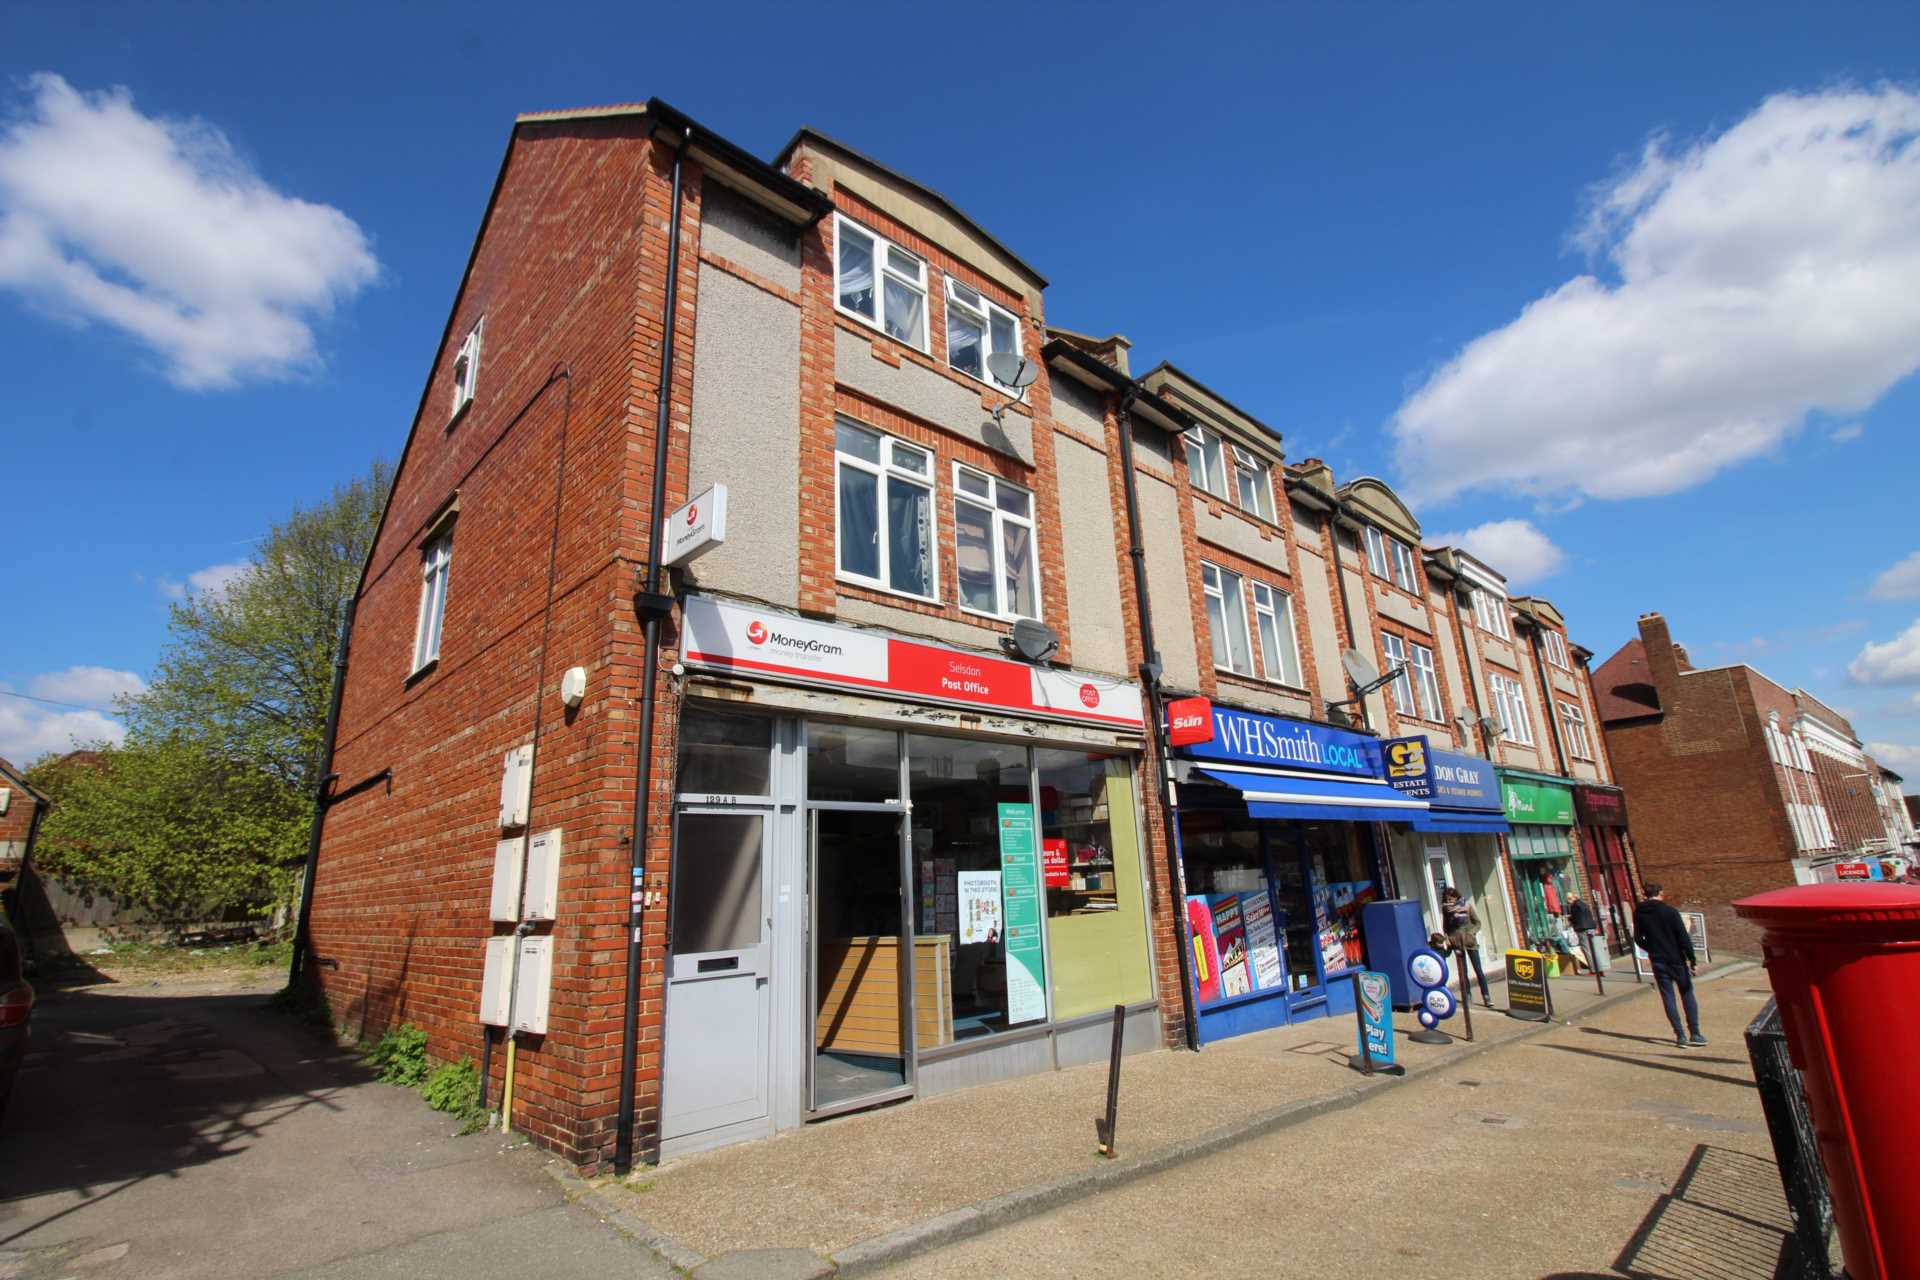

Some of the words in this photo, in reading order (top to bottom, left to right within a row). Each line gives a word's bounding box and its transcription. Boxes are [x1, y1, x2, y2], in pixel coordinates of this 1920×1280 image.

[770, 632, 842, 656] MoneyGram
[949, 661, 981, 677] Selsdon
[941, 677, 962, 691] Post
[964, 680, 989, 695] Office
[1082, 689, 1096, 697] POST
[1216, 713, 1321, 763] WHSmith
[1322, 744, 1363, 769] LOCAL
[1434, 765, 1455, 781] DON
[1456, 767, 1479, 785] GRAY
[1393, 779, 1427, 789] ESTATE
[1402, 788, 1430, 797] ENTS
[1368, 1042, 1388, 1056] ere!
